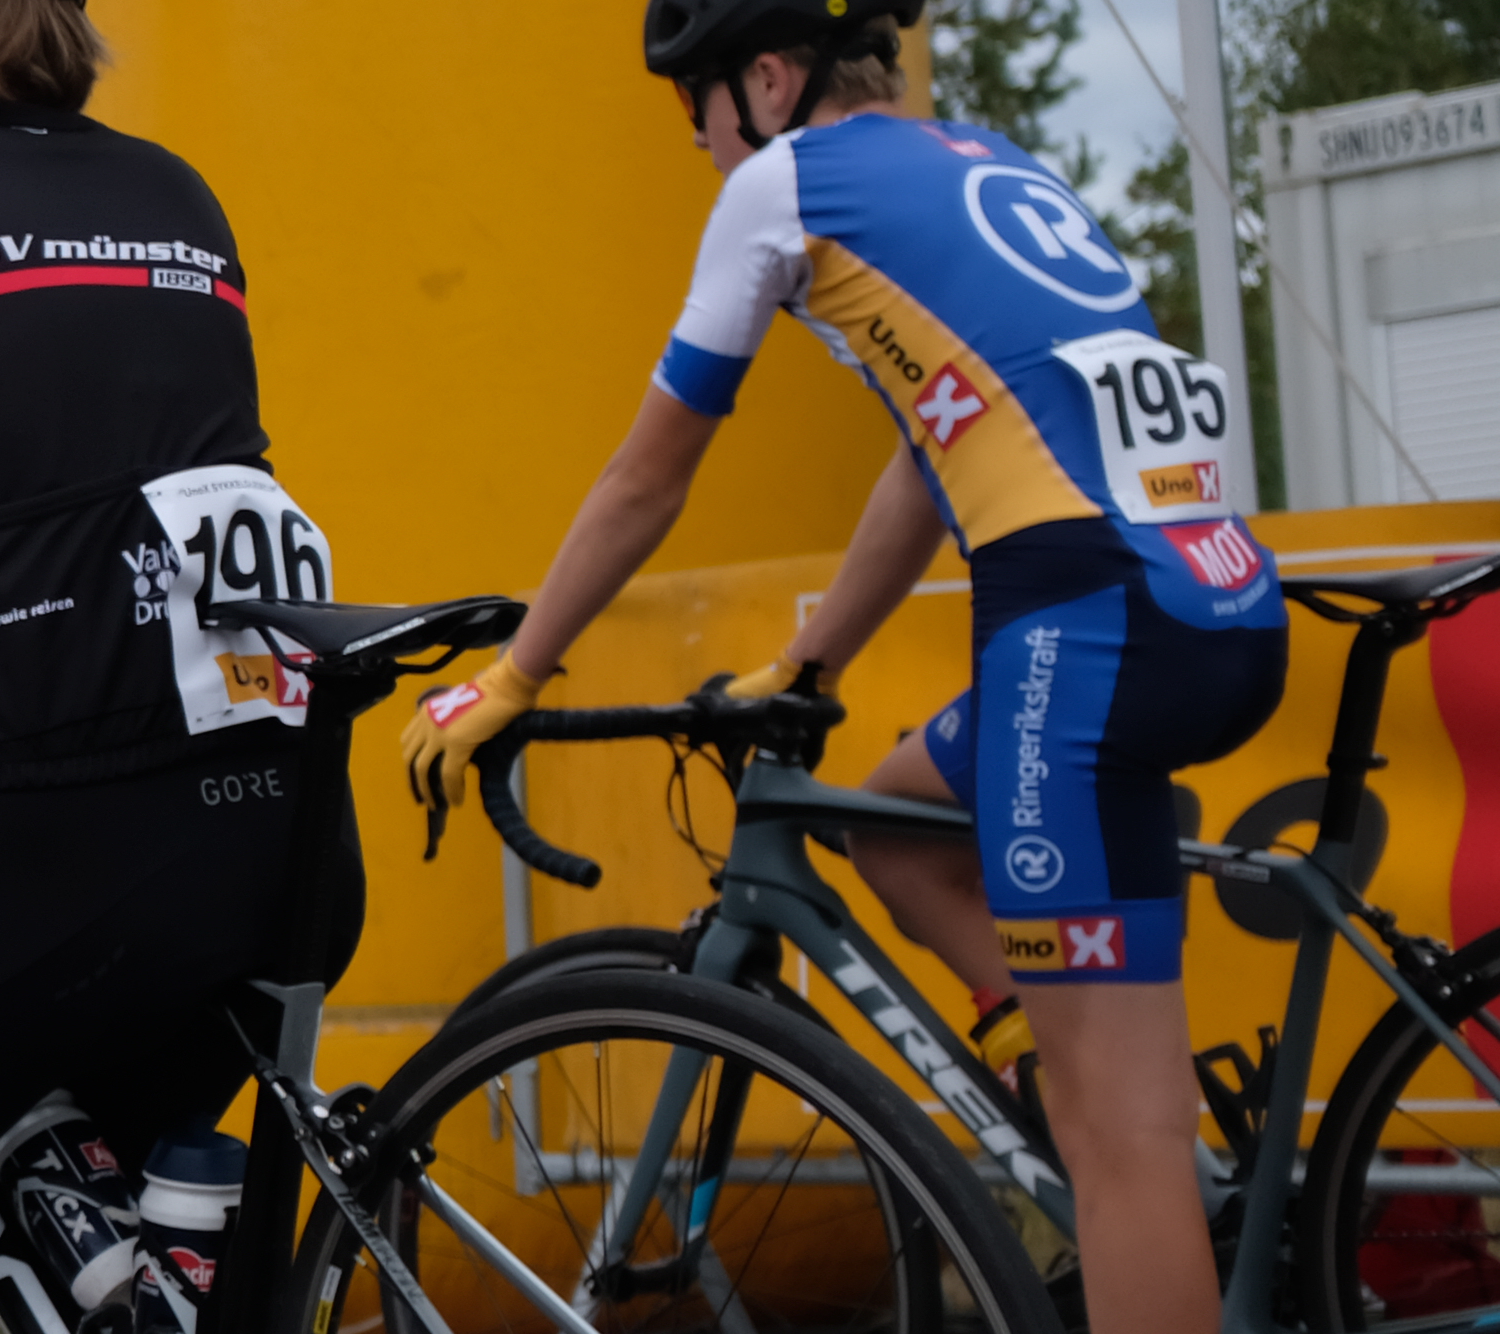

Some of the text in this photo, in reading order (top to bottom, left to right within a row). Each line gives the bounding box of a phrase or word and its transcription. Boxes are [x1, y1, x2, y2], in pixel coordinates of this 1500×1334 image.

[43, 235, 228, 275] münster
[156, 270, 210, 292] 1895
[868, 318, 925, 384] Uno
[1095, 358, 1227, 451] 195
[1151, 477, 1194, 497] Uno
[183, 508, 327, 630] 196
[1186, 517, 1258, 588] MOT
[1012, 624, 1062, 829] Ringerikskraft
[200, 767, 285, 806] GORE
[825, 939, 1067, 1198] TREK
